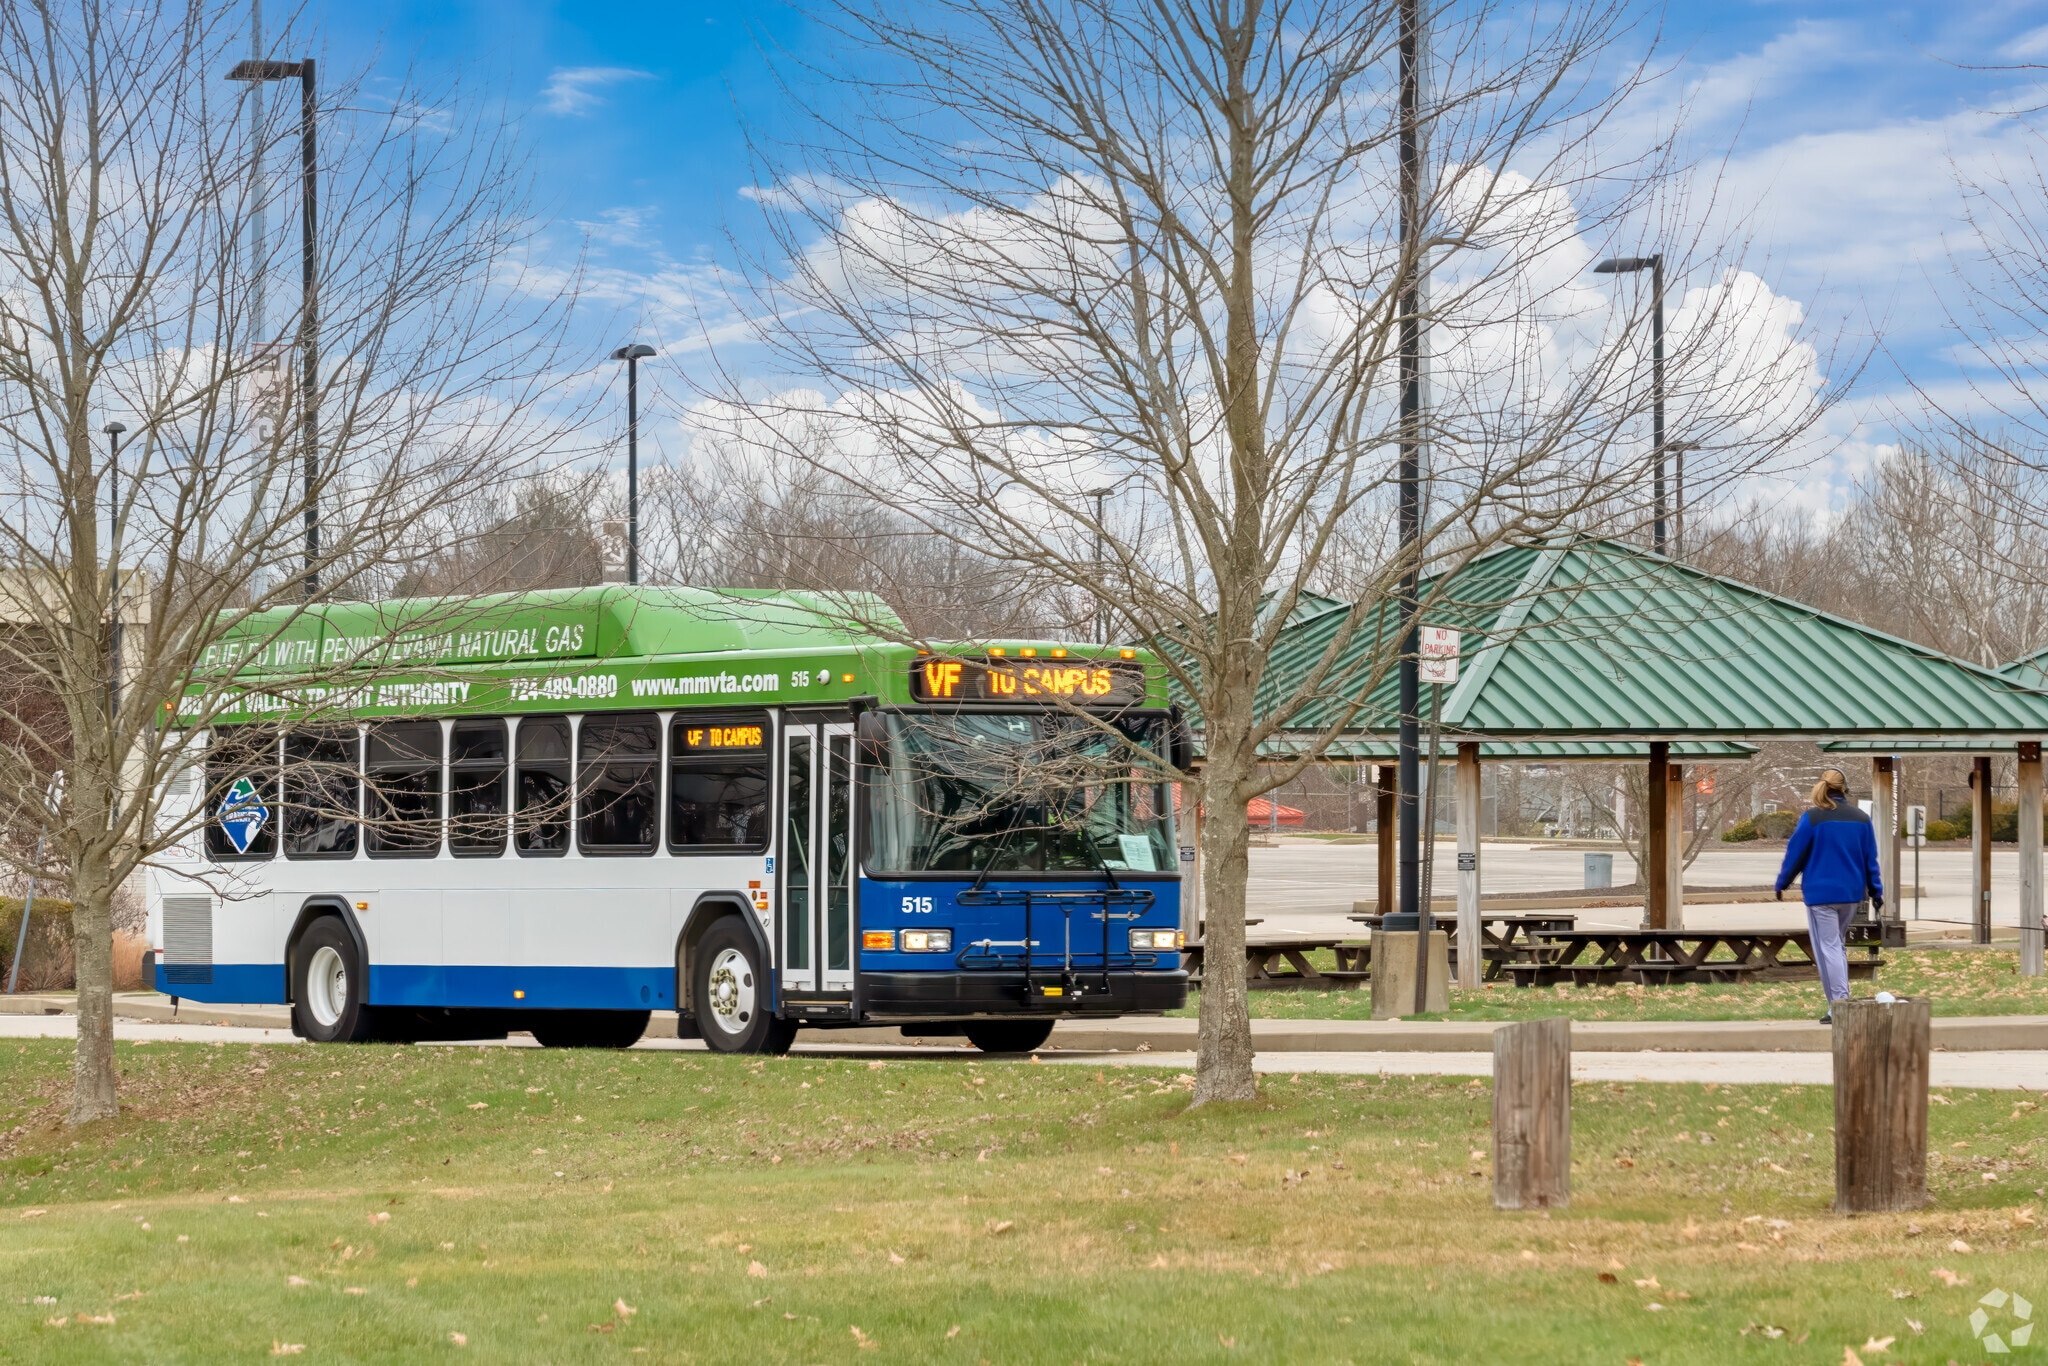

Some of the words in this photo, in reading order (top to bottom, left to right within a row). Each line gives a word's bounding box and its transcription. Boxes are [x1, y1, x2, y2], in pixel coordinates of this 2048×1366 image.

[274, 639, 318, 666] WITH
[321, 633, 453, 663] PENNSLVANIA
[457, 628, 539, 658] NATURAL
[545, 624, 584, 653] GAS
[1435, 629, 1447, 641] NO
[1424, 643, 1456, 657] PARKING
[510, 674, 617, 701] 724-489-0880
[631, 670, 779, 697] www.mmvta.com
[791, 671, 809, 688] 515
[925, 662, 962, 697] VF
[987, 668, 1016, 694] TO
[1023, 668, 1112, 695] CAMPUS
[376, 681, 471, 707] AUTHORITY
[687, 729, 703, 746] VF
[709, 728, 723, 747] TO
[724, 727, 762, 746] CAMPUS
[901, 896, 933, 914] 515
